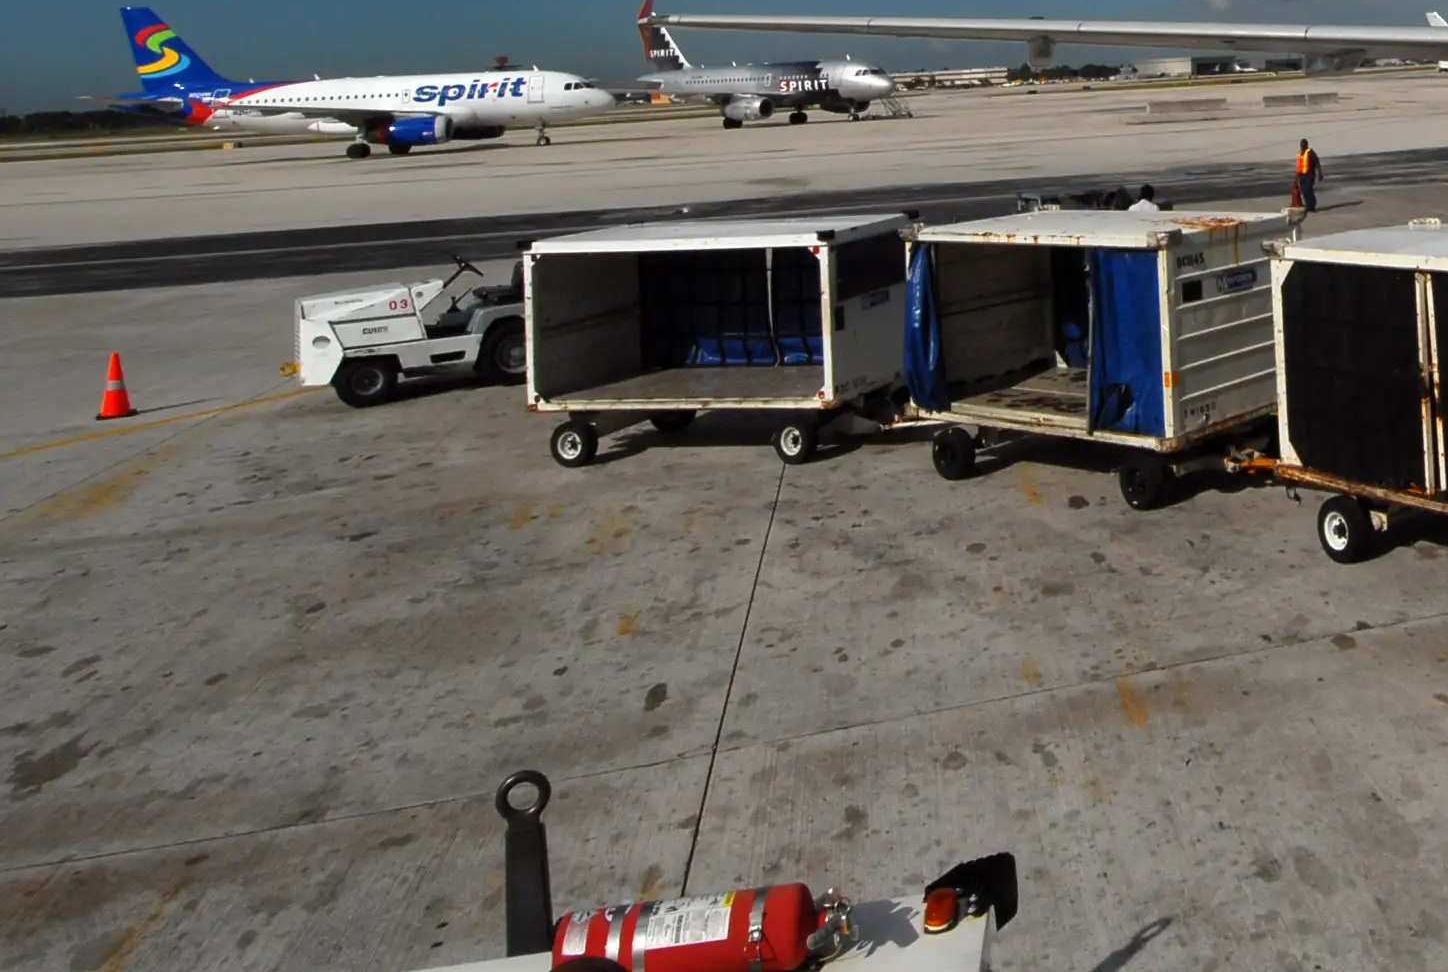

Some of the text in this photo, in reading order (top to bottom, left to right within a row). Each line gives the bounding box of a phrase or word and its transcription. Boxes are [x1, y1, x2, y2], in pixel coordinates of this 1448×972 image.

[650, 49, 675, 58] SPIRIT
[413, 77, 527, 106] spirit
[780, 79, 828, 92] SPIRIT
